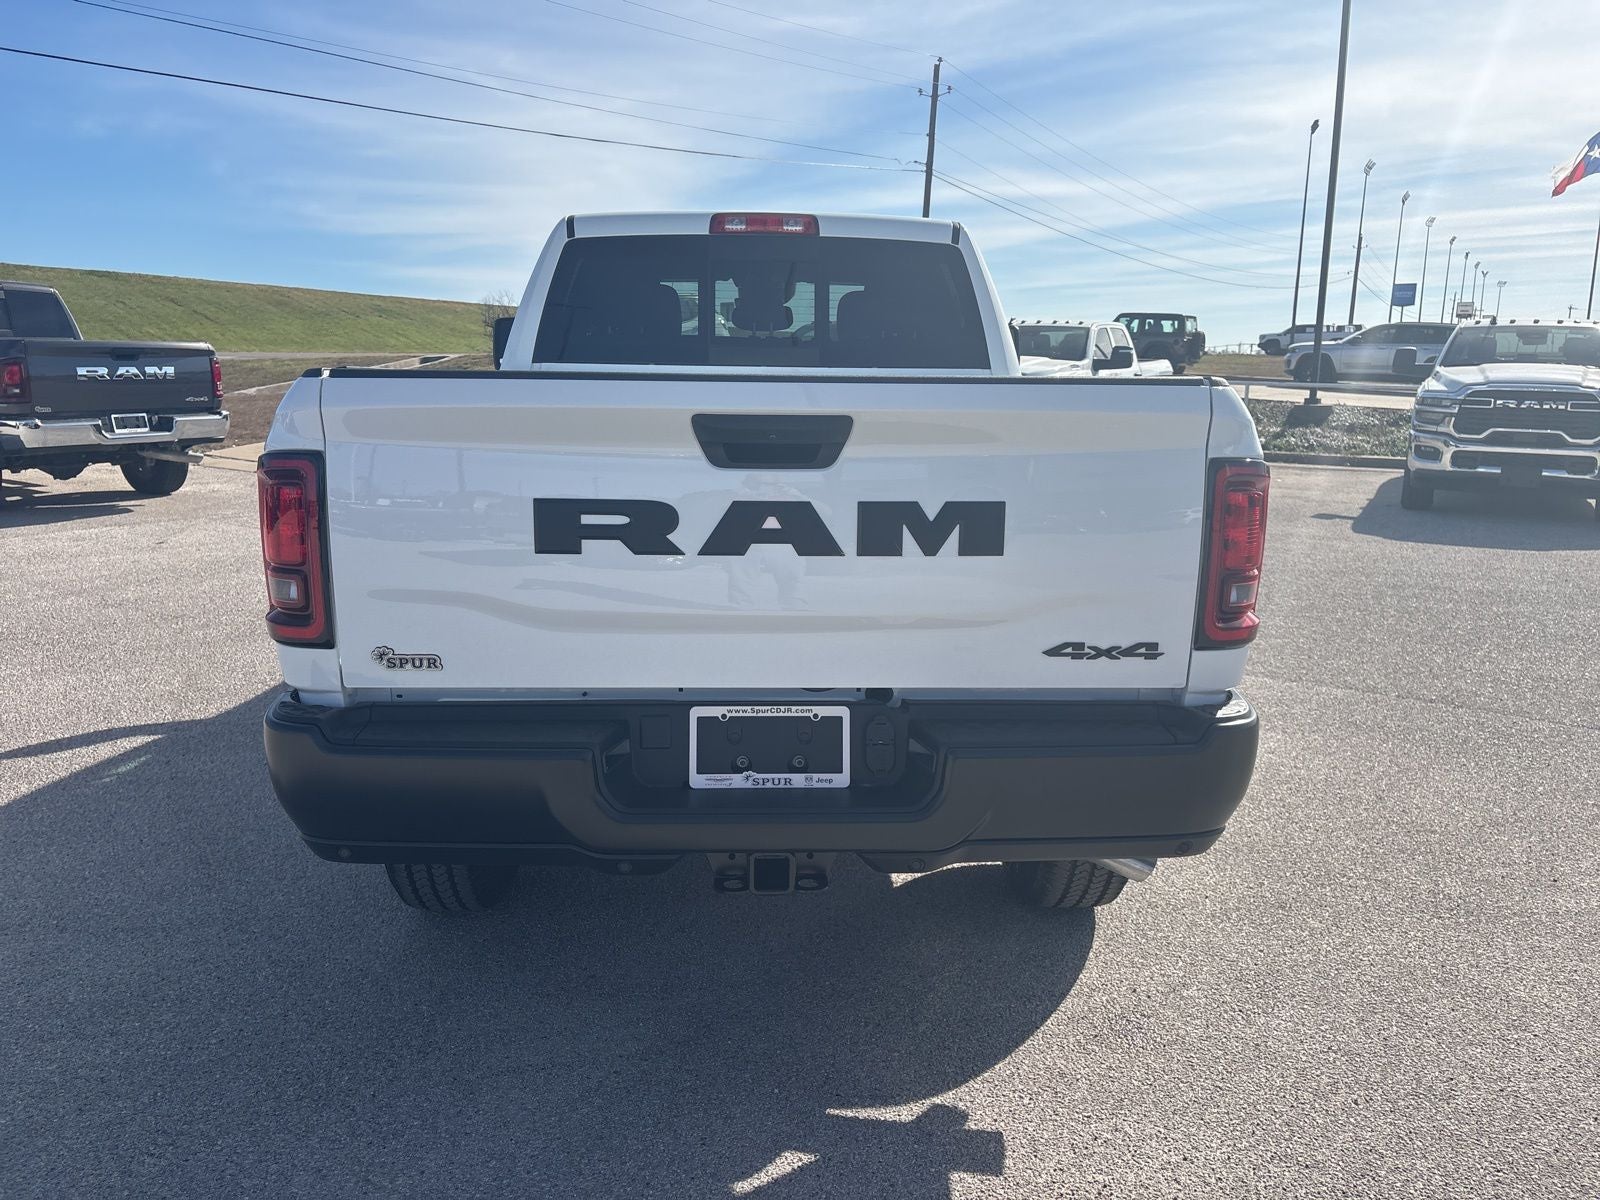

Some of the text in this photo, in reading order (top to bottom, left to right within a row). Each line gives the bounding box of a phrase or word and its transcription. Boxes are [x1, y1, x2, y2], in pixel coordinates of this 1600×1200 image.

[75, 366, 175, 381] RAM
[1495, 399, 1567, 409] RAM
[533, 498, 1006, 557] RAM
[1041, 641, 1166, 660] 4x4
[386, 657, 439, 669] SPUR
[726, 707, 813, 715] www.SpurCDJR.com
[752, 777, 793, 786] SPUR
[815, 777, 834, 785] Jeep
